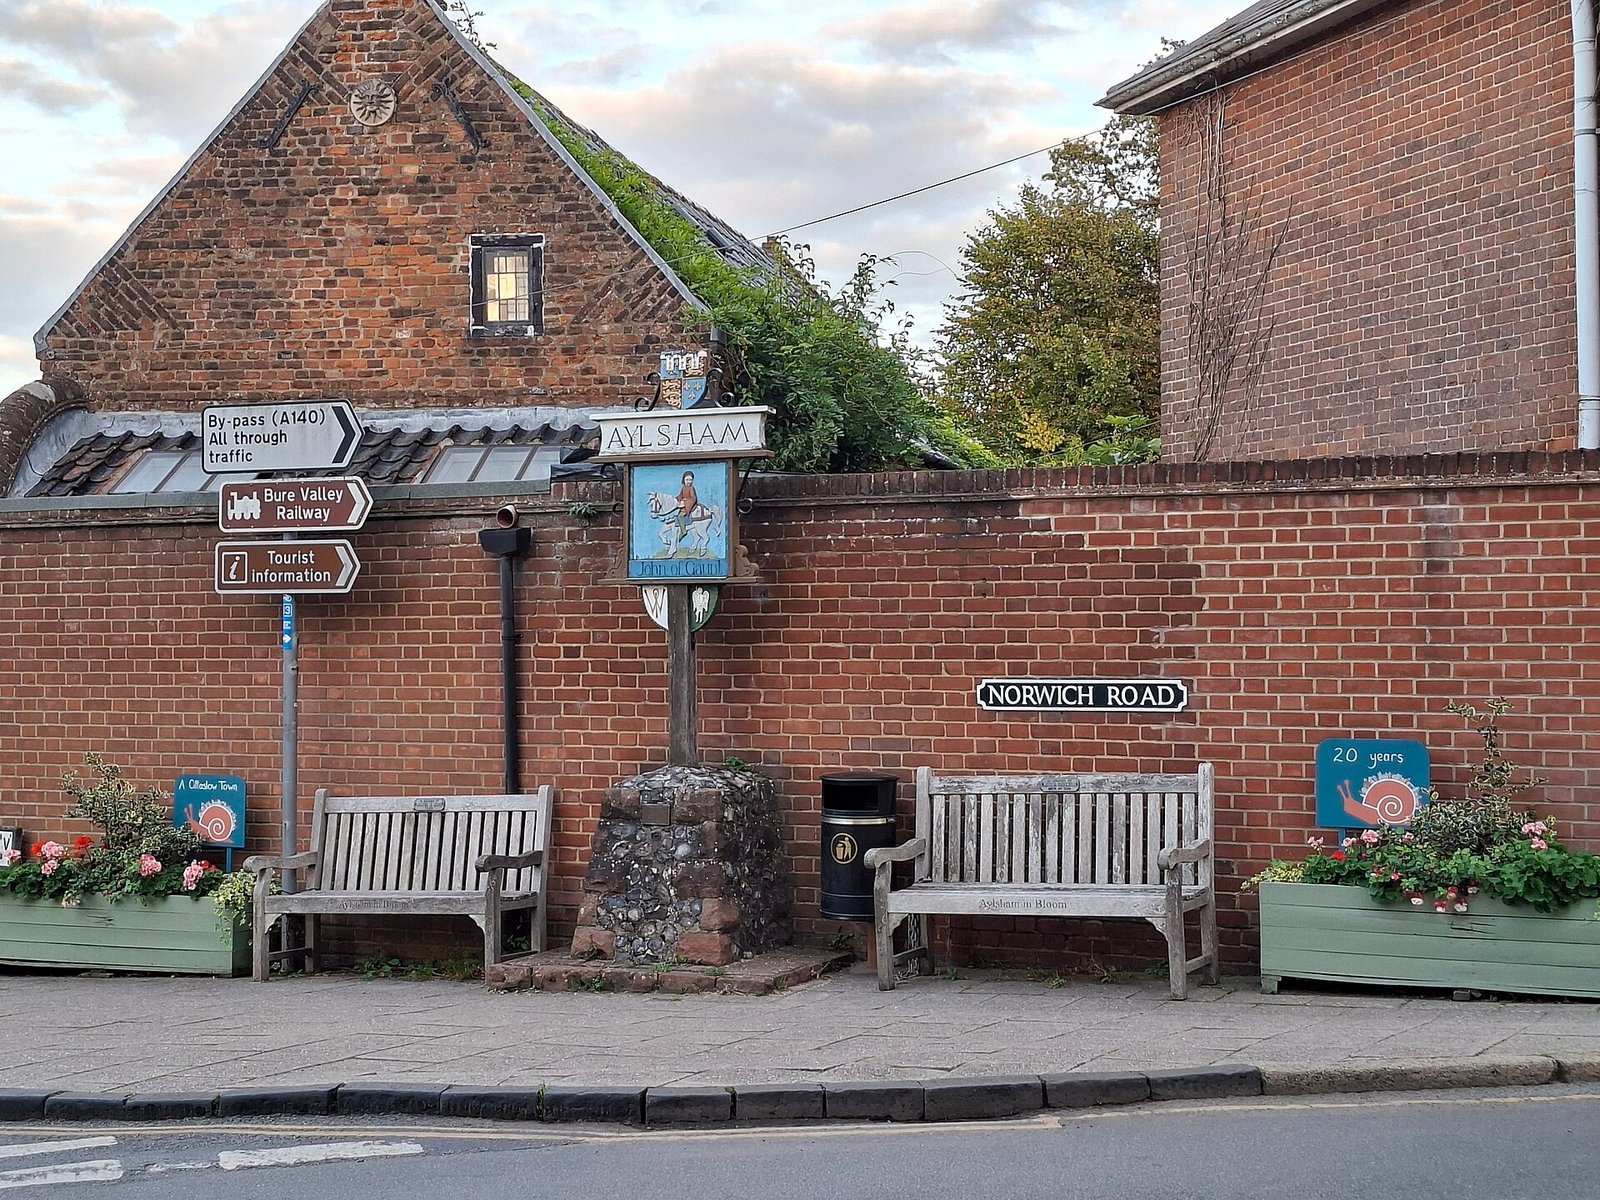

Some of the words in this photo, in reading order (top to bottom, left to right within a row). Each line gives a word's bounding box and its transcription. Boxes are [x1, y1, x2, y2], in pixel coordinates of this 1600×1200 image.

[208, 414, 265, 430] By-pass
[271, 408, 326, 427] (A140)
[209, 432, 228, 446] All
[233, 430, 288, 445] through
[607, 421, 750, 449] AYLSHAM
[209, 449, 253, 463] traffic
[264, 489, 295, 503] Bure
[300, 487, 343, 503] Valley
[276, 507, 330, 522] Railway
[267, 551, 314, 564] Tourist
[252, 568, 331, 583] information
[637, 562, 666, 576] John
[670, 561, 683, 575] of
[685, 560, 722, 575] Gaunt
[987, 685, 1094, 706] NORWICH
[1107, 686, 1175, 706] ROAD
[1333, 748, 1358, 762] 20
[1367, 752, 1404, 769] years
[178, 779, 185, 790] A
[218, 780, 238, 791] Town
[979, 898, 1020, 910] Aylsham
[1023, 899, 1032, 909] in
[1035, 899, 1067, 909] Bloom
